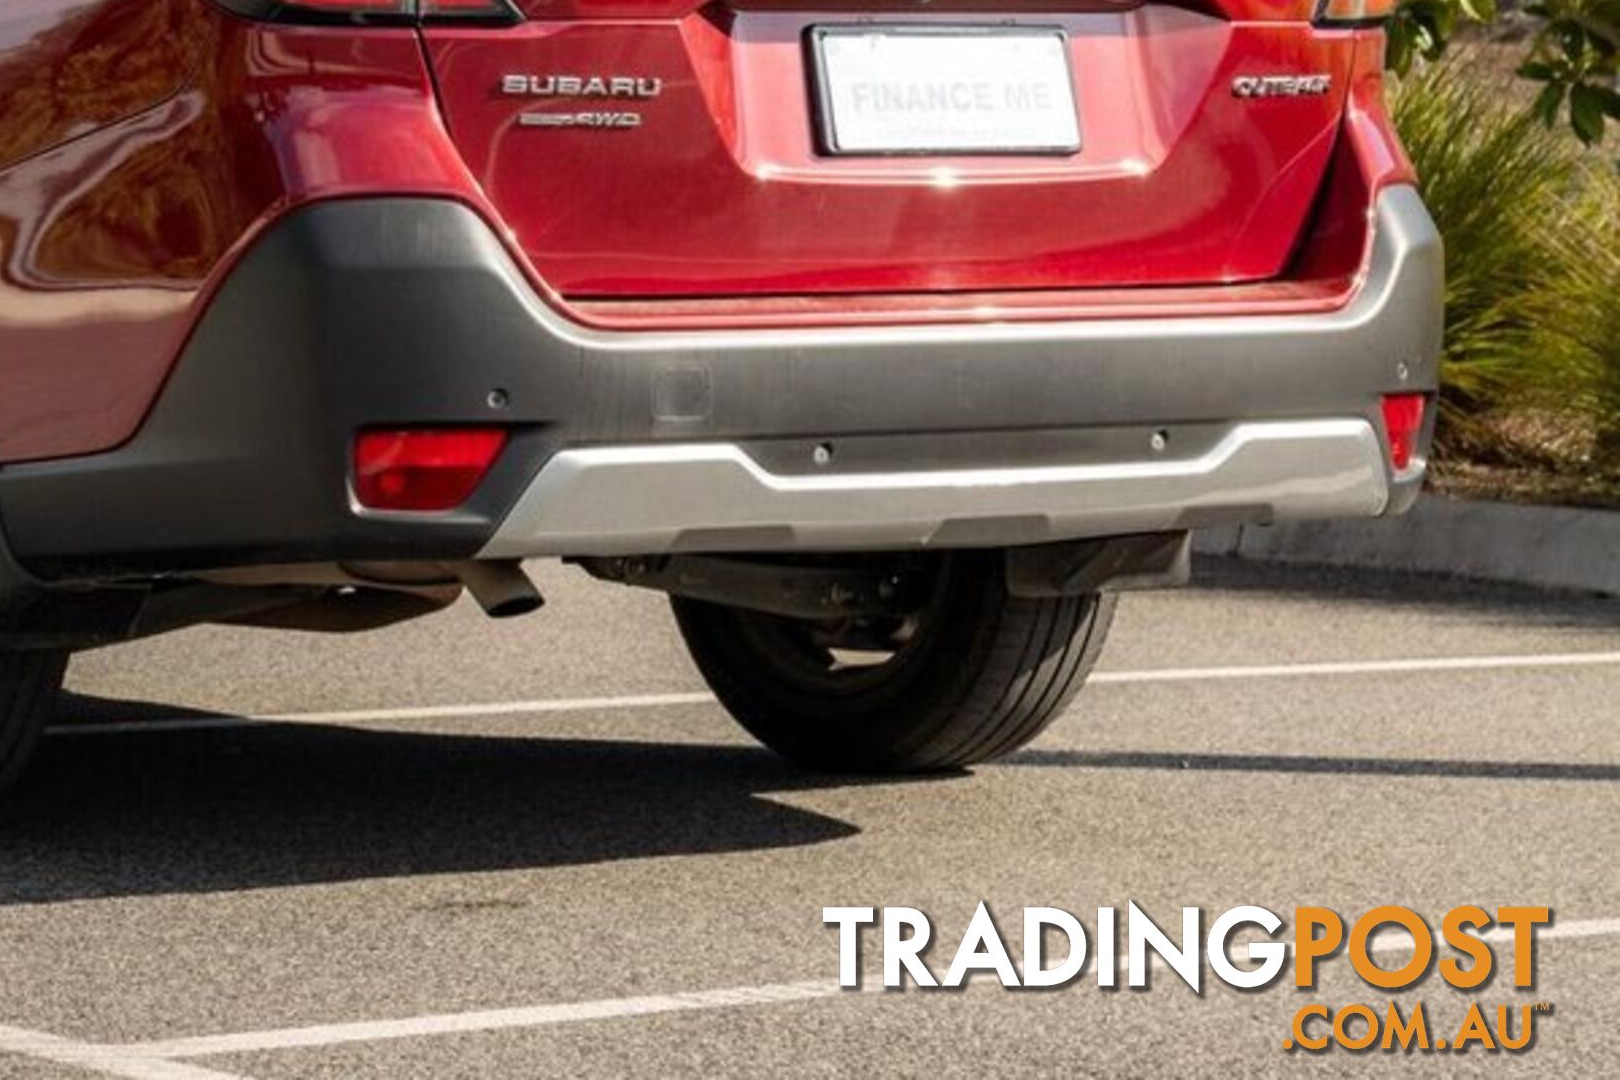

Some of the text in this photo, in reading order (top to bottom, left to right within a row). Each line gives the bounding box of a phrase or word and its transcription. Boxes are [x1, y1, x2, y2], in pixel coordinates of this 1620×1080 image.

[501, 74, 663, 97] SUBARU
[850, 81, 1054, 113] FINANCE ME
